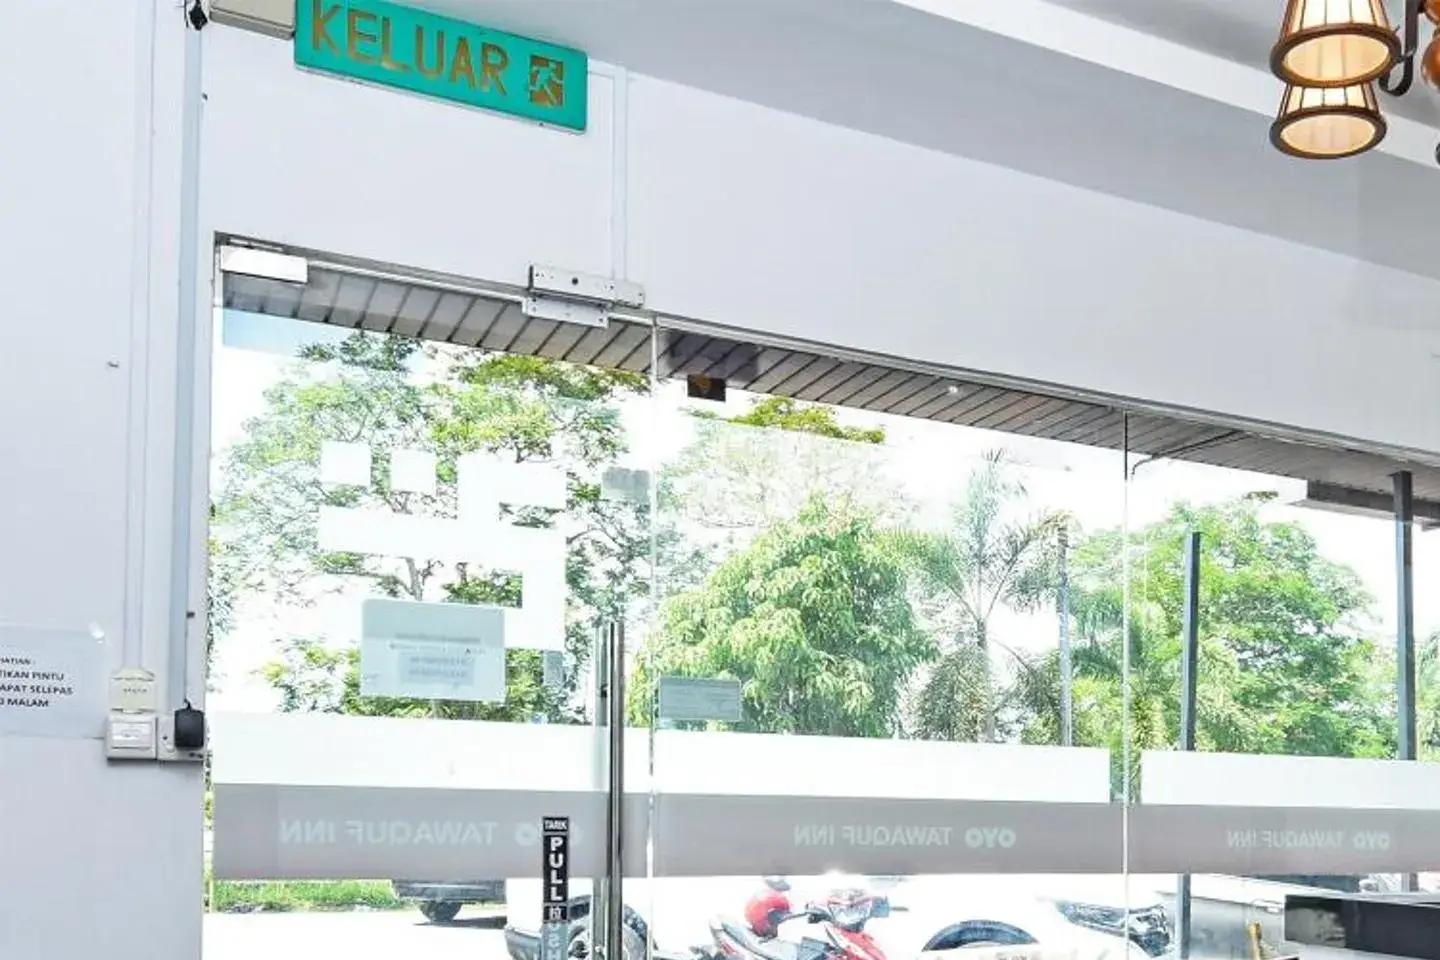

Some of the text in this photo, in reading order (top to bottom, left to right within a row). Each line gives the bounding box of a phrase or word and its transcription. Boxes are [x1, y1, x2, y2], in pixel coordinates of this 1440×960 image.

[312, 0, 508, 96] KELUAR
[32, 671, 64, 682] PINTU
[30, 685, 73, 696] SELEPAS
[7, 697, 49, 708] MALAM
[550, 836, 564, 902] PULL
